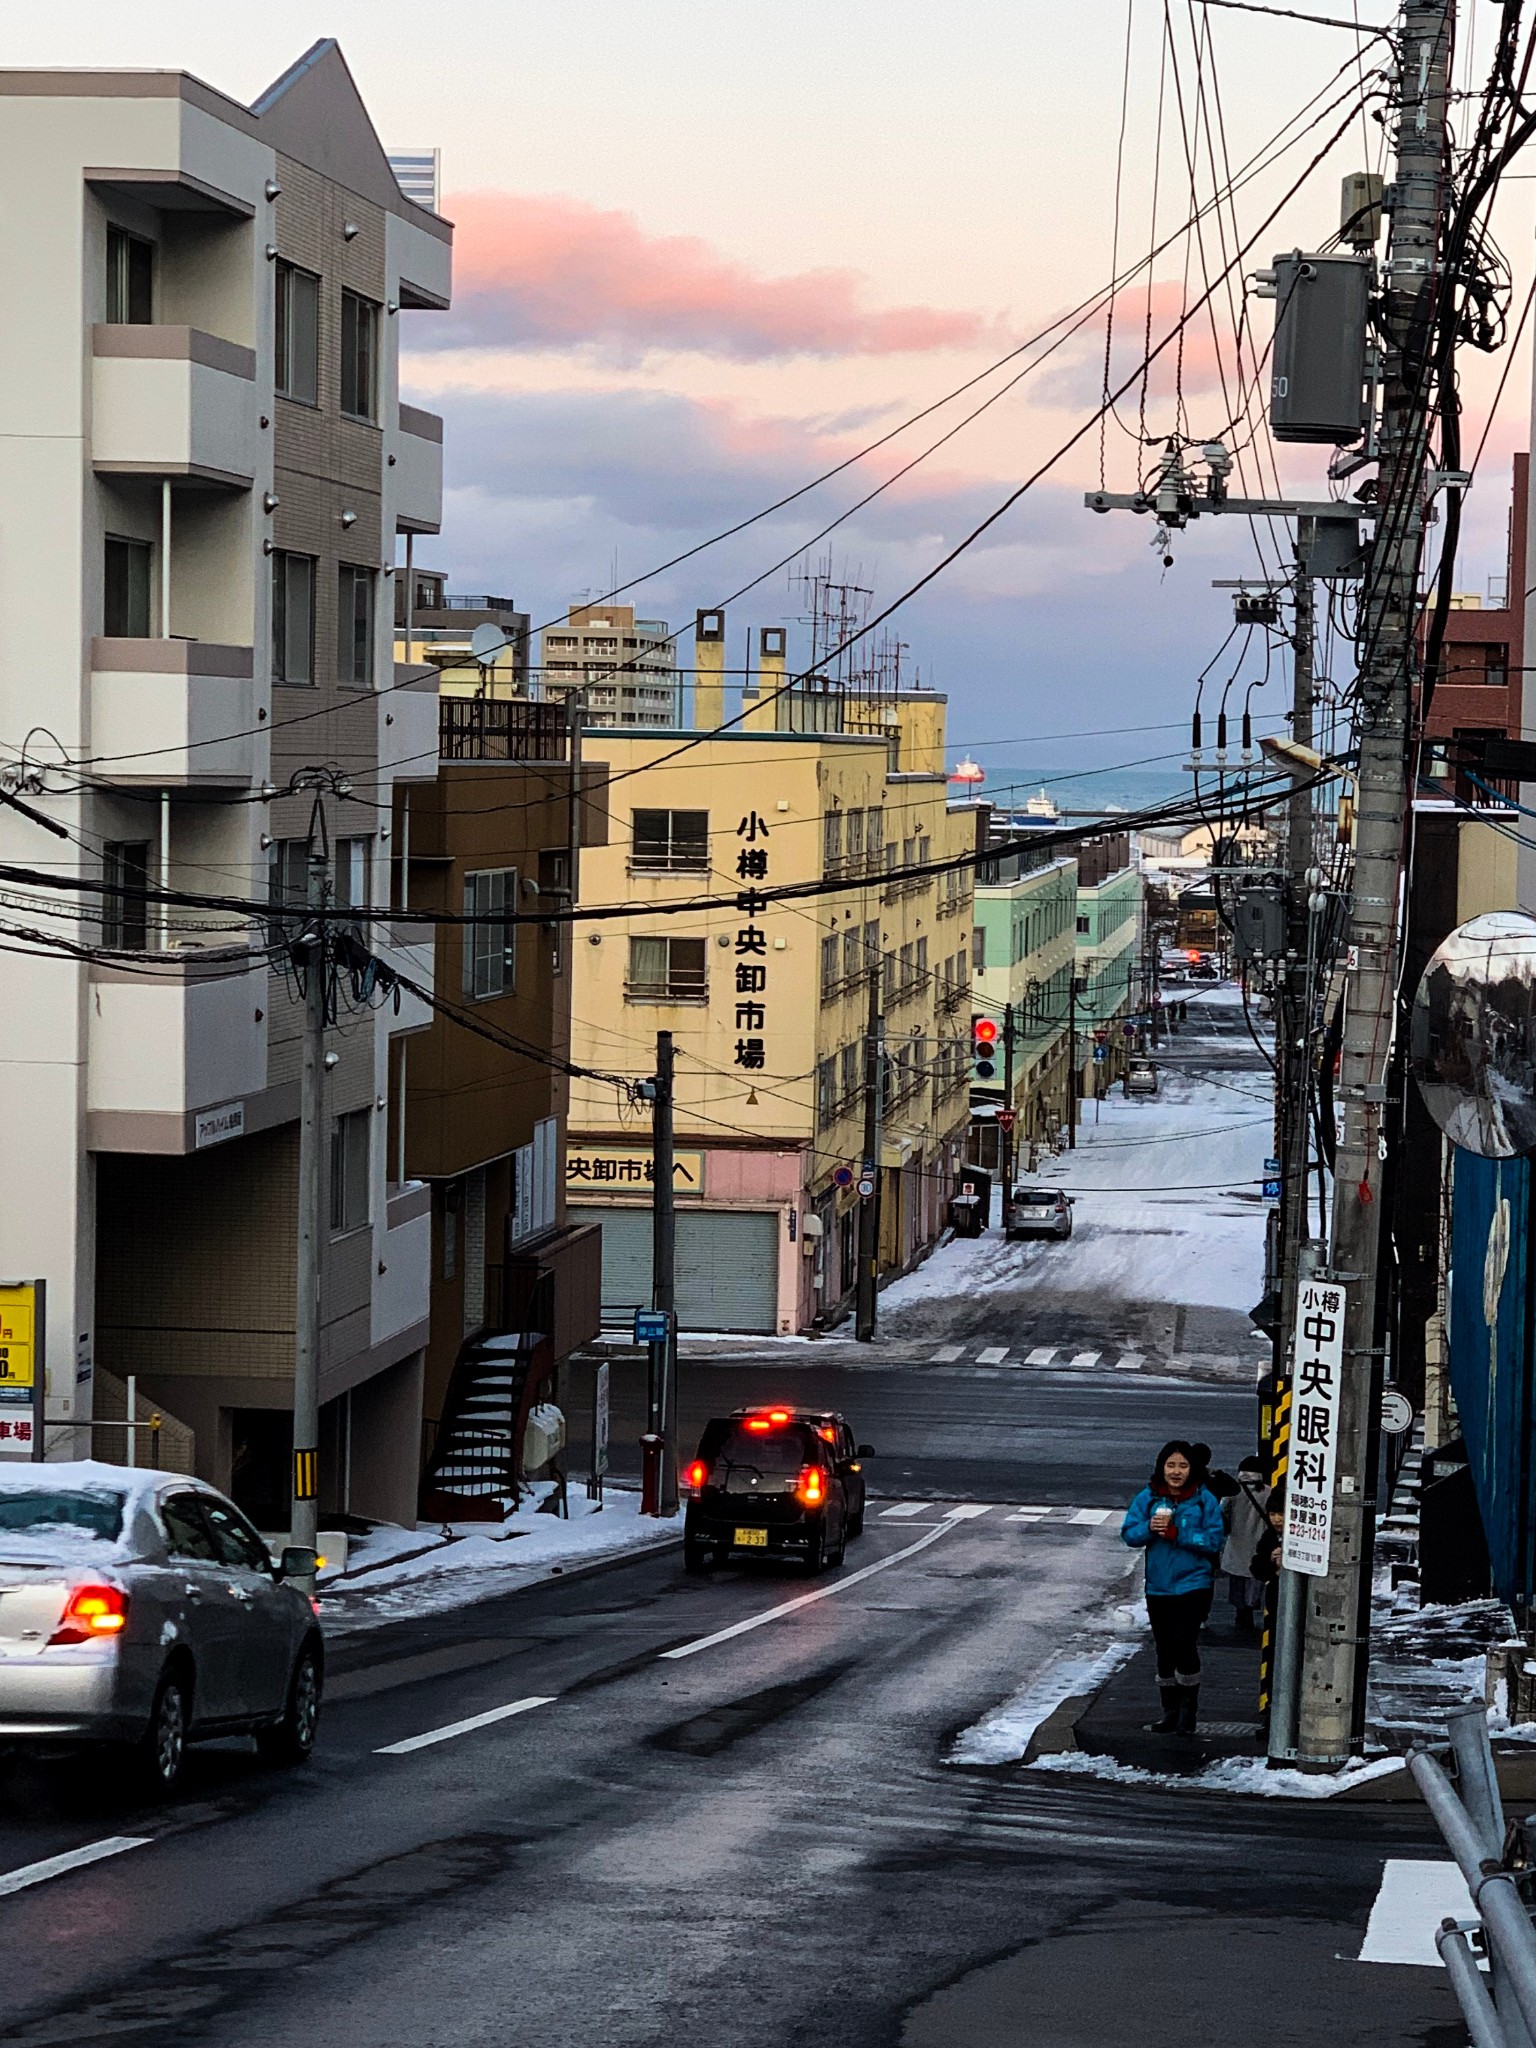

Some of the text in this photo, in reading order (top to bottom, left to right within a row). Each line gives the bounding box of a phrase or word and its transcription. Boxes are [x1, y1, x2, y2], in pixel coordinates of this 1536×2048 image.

[861, 1183, 872, 1193] 30
[1302, 1288, 1341, 1314] 小樽
[1293, 1311, 1336, 1494] 中央眼科
